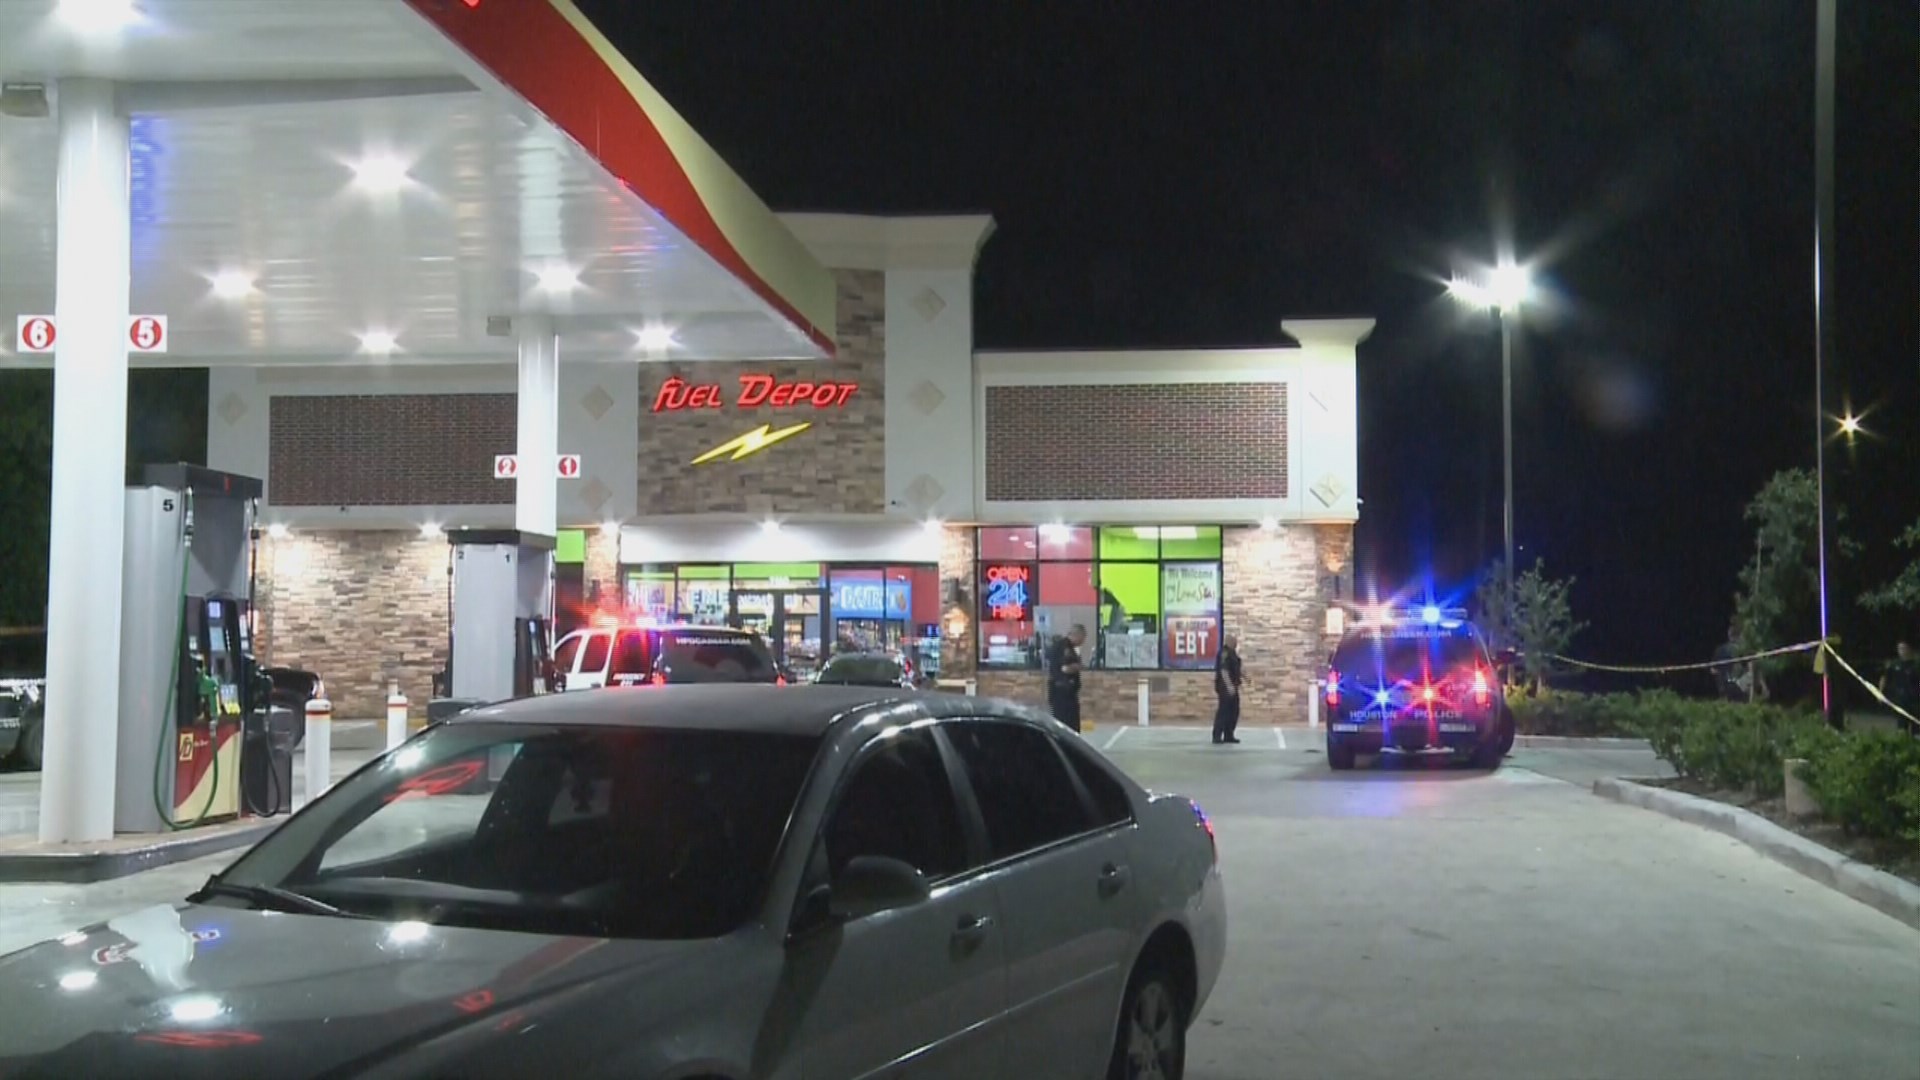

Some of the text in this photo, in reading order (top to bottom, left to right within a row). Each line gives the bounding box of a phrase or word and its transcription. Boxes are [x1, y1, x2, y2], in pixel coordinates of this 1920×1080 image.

[29, 319, 49, 349] 6
[137, 319, 156, 349] 5
[737, 373, 858, 411] DEPOT
[502, 457, 514, 476] 2
[163, 498, 174, 512] 5
[457, 551, 465, 560] 2
[987, 566, 1028, 581] OPEN
[987, 580, 1028, 606] 24
[1175, 631, 1209, 656] EBT
